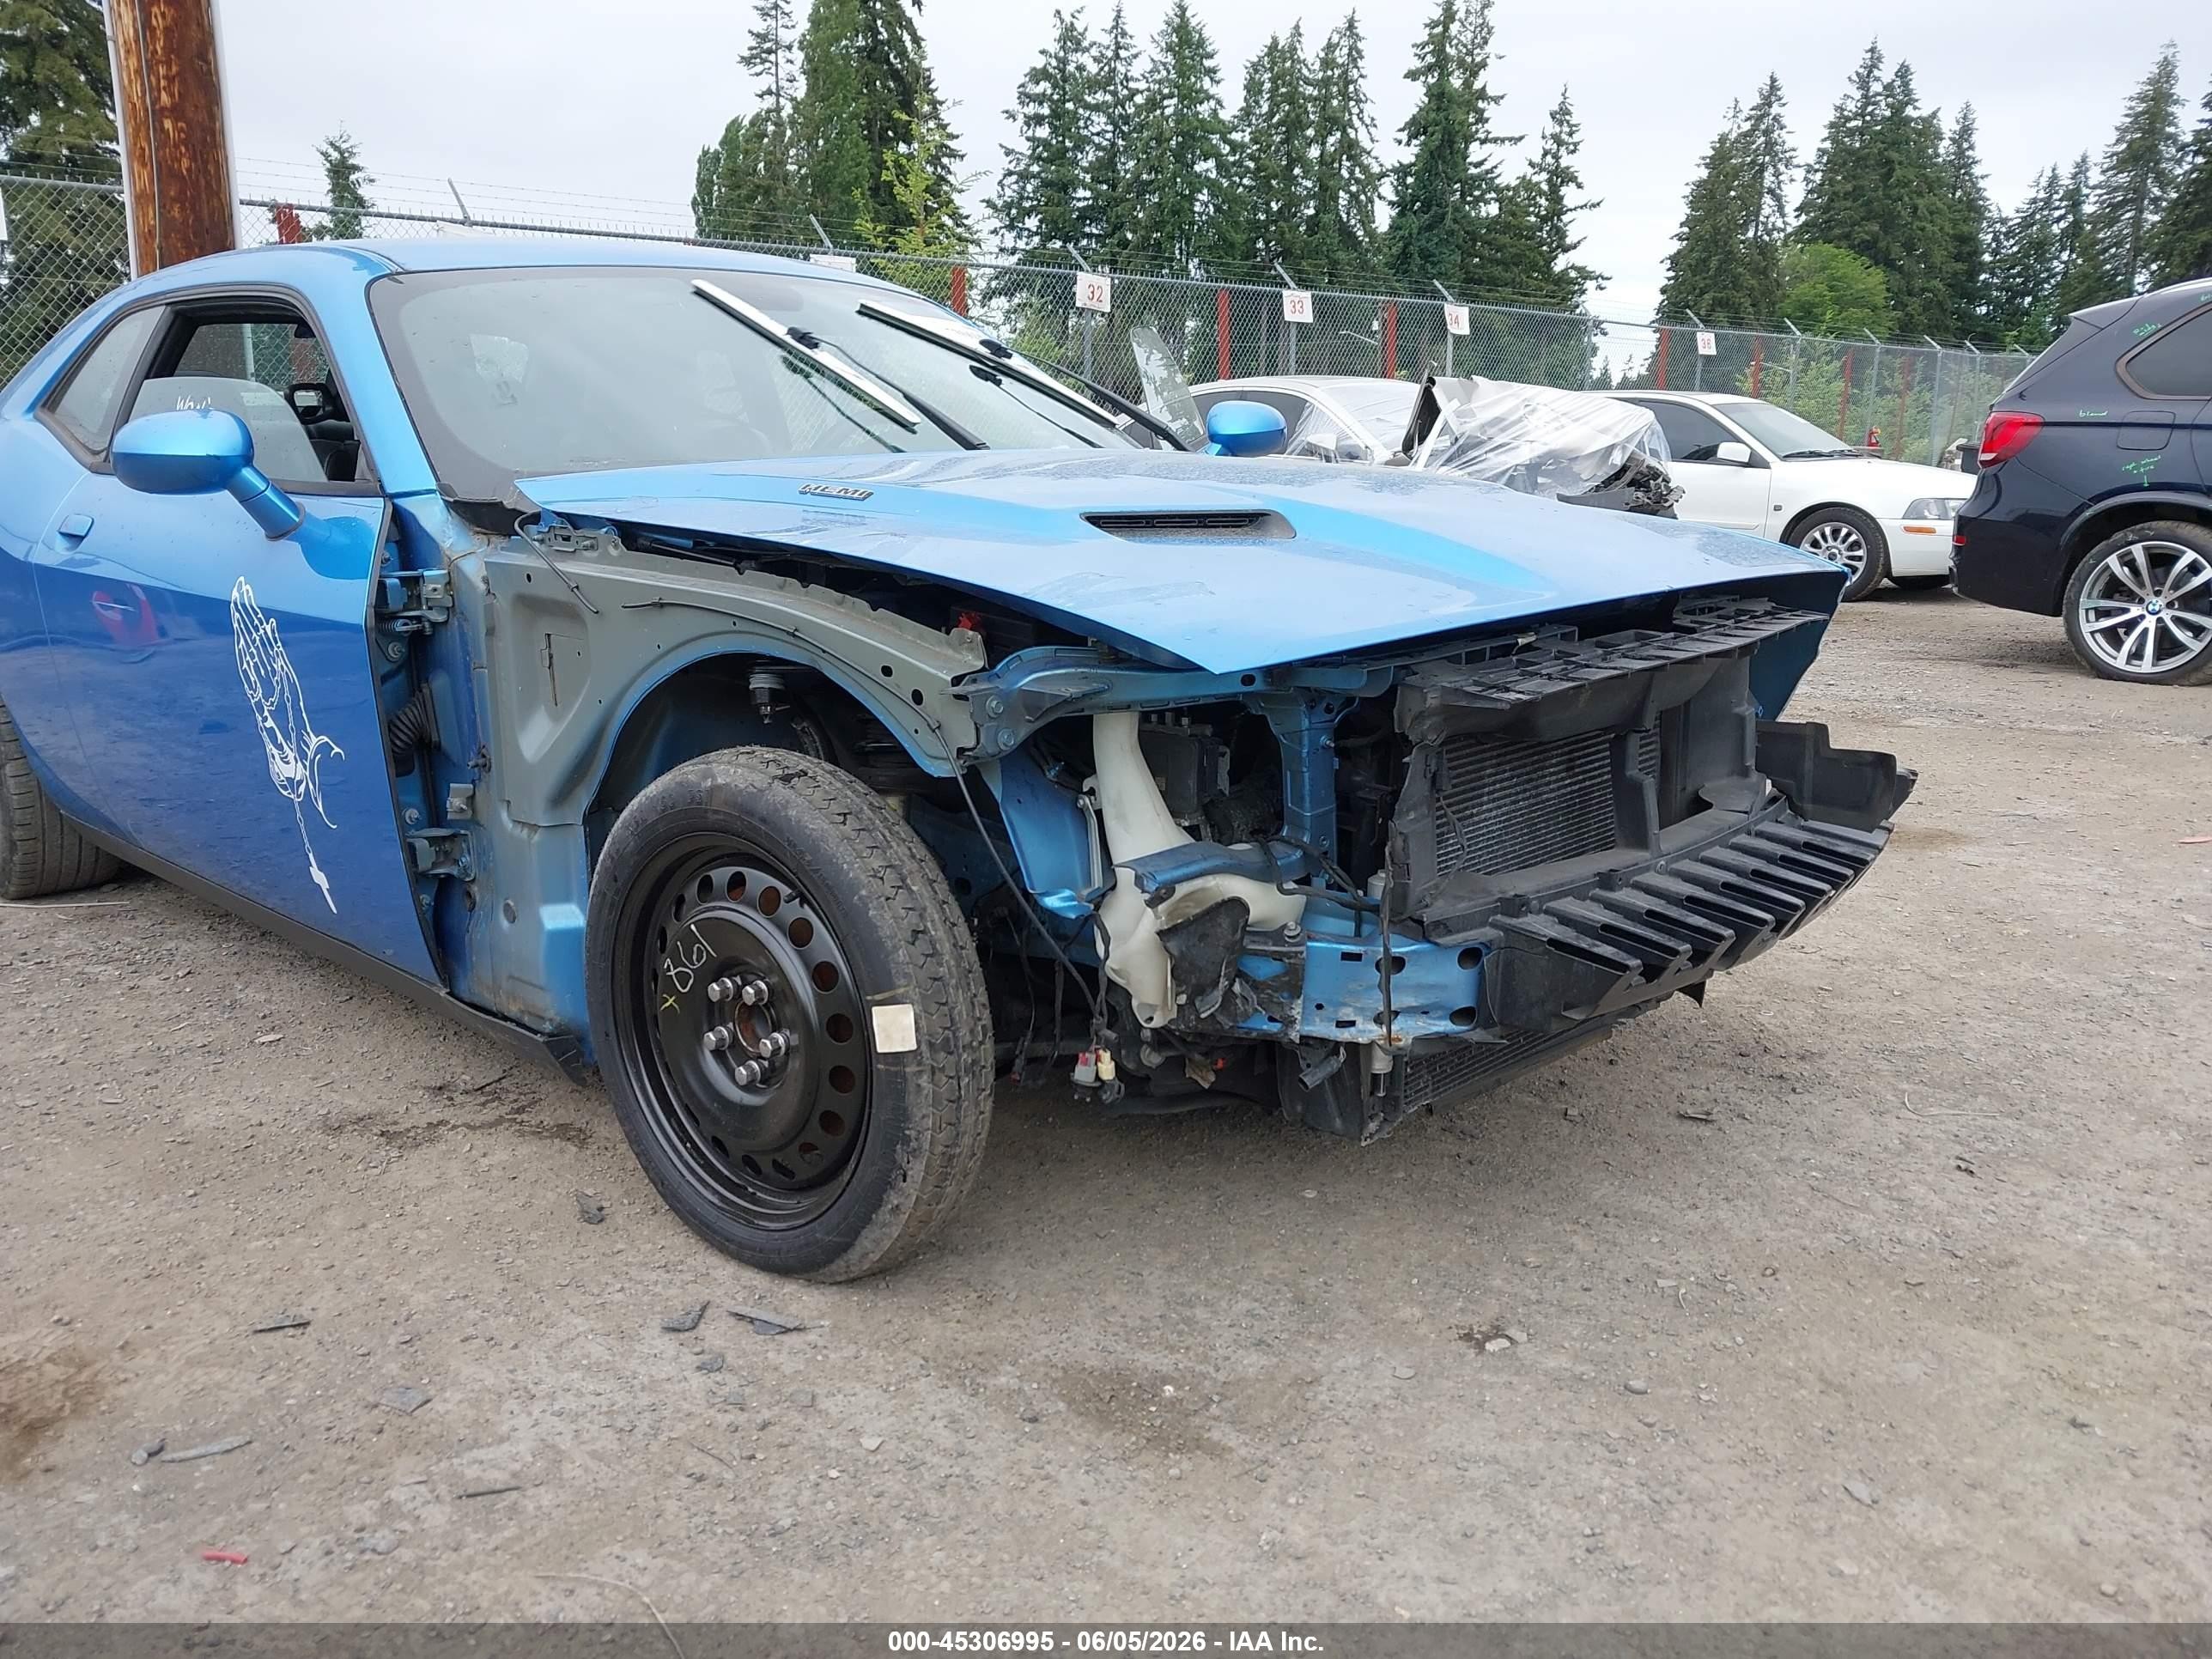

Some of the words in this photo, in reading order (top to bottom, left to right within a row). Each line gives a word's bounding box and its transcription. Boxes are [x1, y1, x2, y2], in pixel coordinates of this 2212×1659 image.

[1087, 283, 1103, 303] 32
[1290, 300, 1304, 315] 33
[1449, 313, 1460, 330] 34
[798, 483, 874, 501] HEMI
